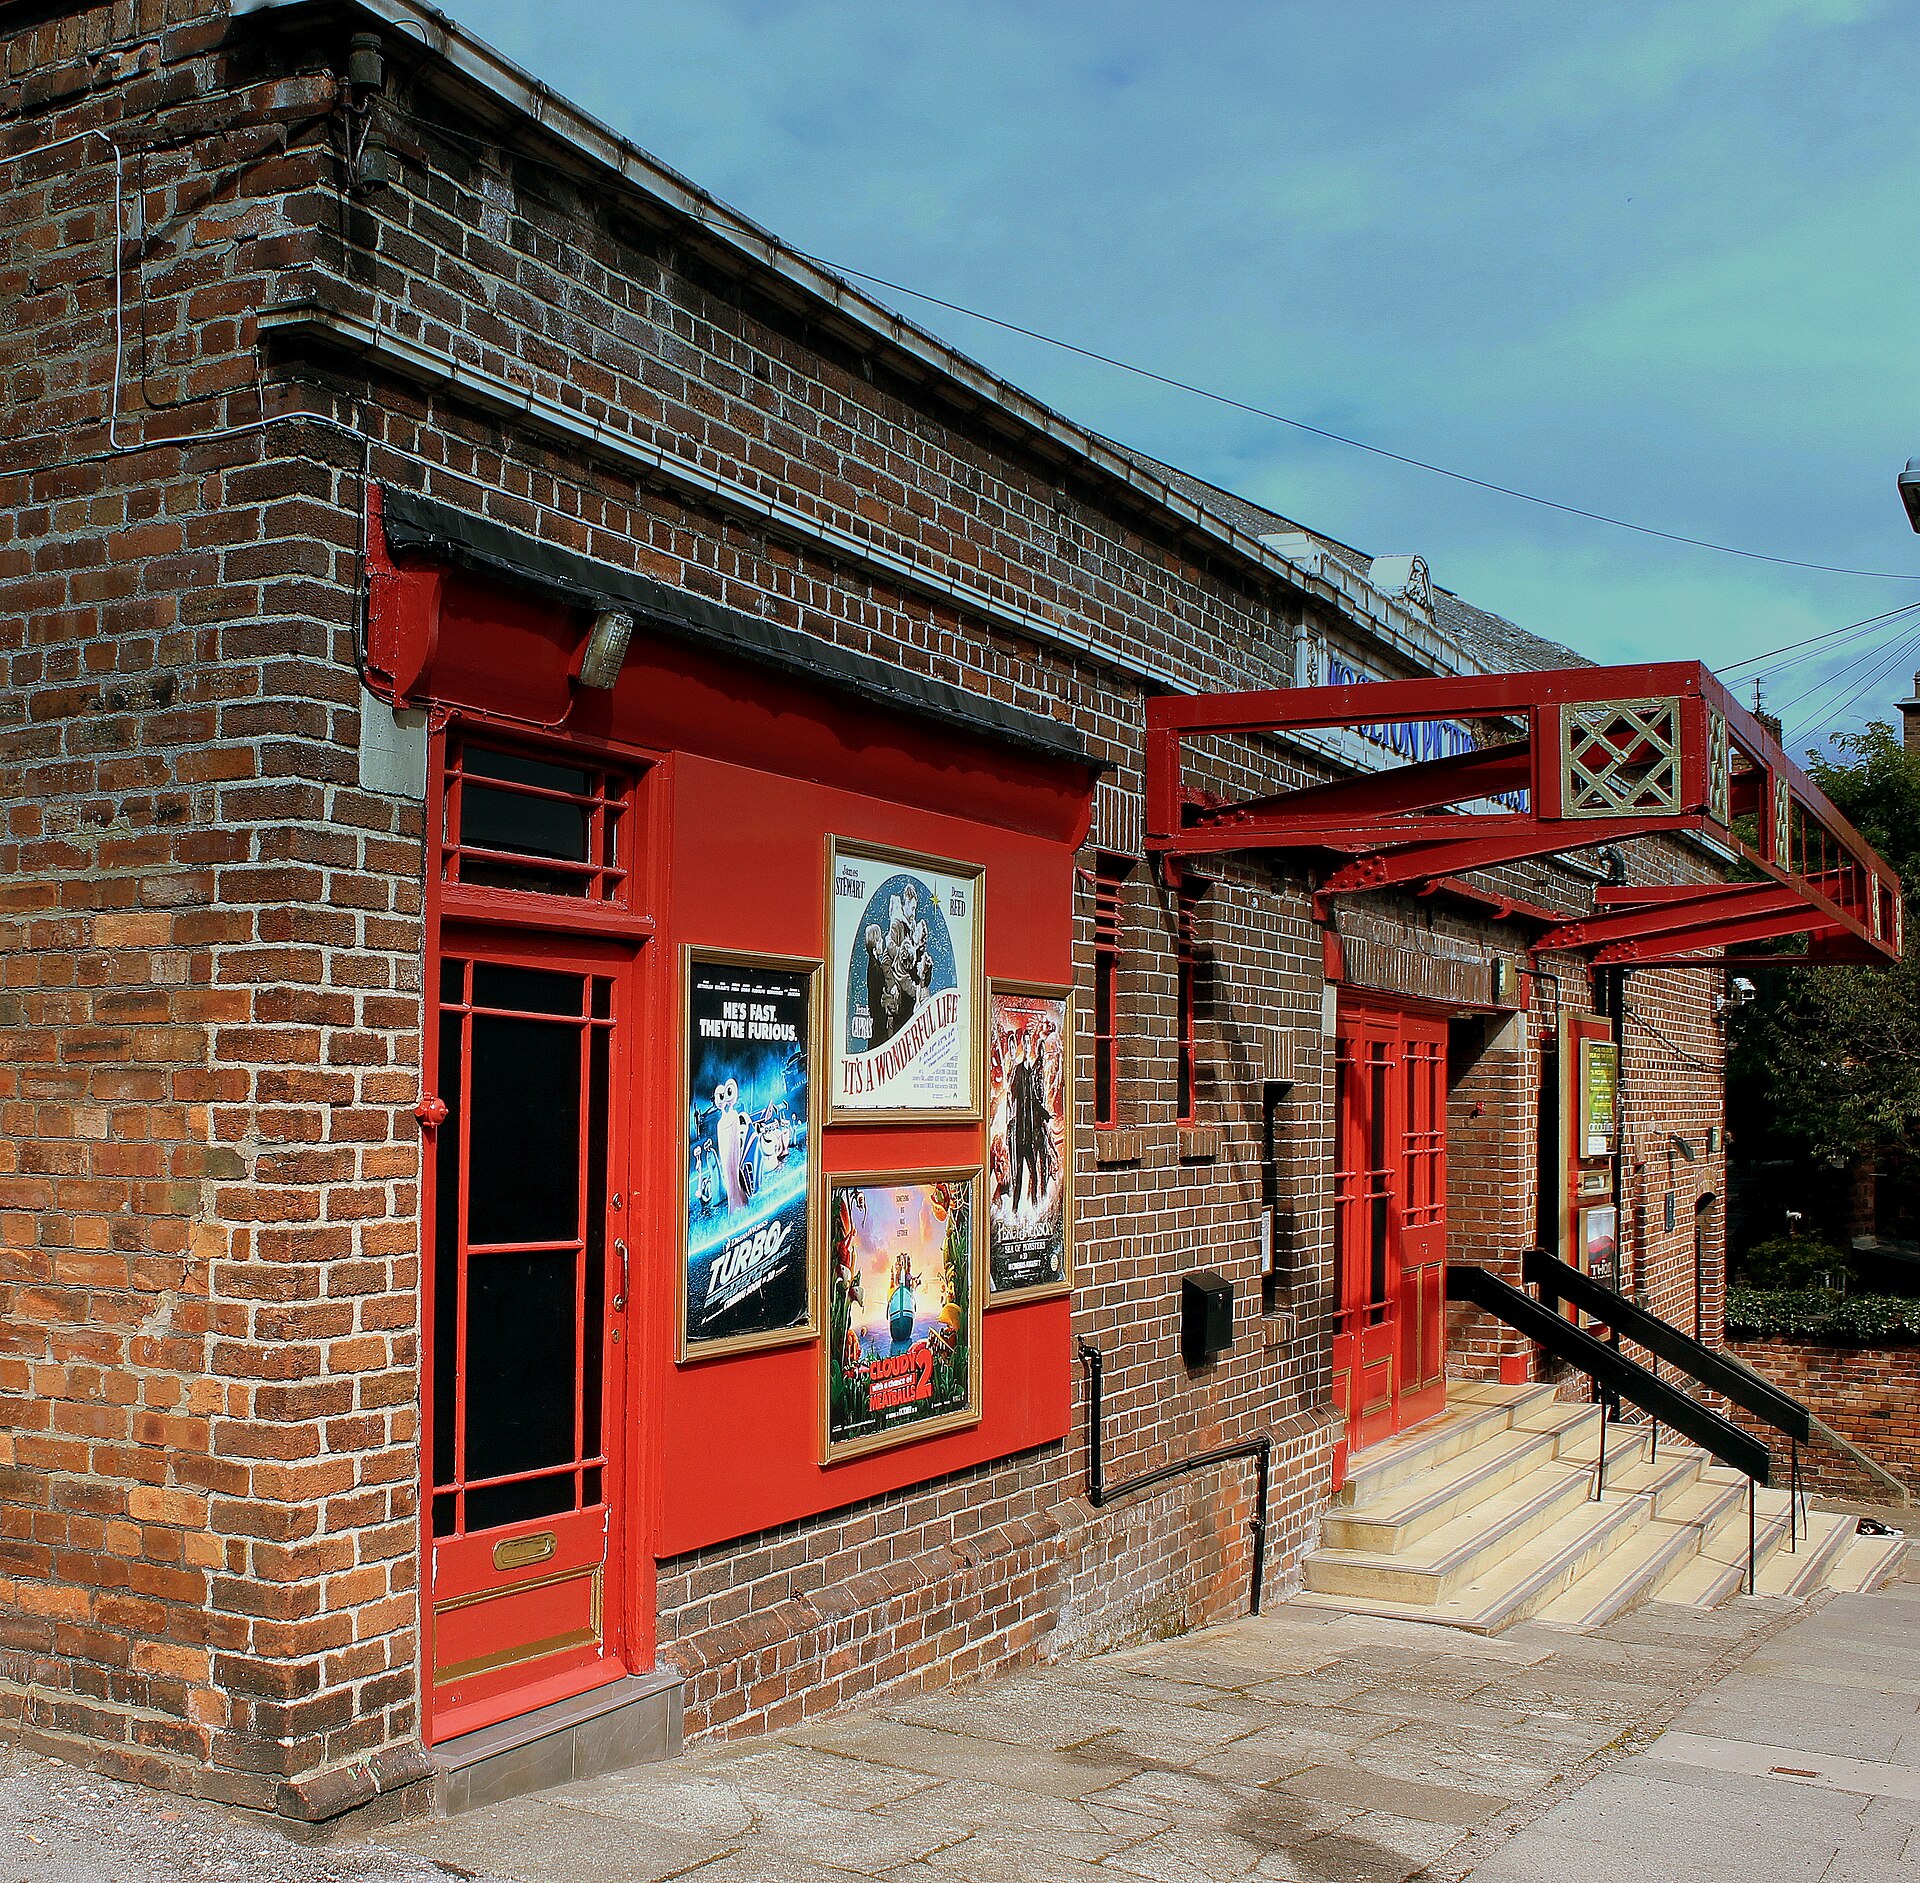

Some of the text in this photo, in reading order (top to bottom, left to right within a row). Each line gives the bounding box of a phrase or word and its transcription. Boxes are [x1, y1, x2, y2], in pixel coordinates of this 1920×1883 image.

[835, 877, 866, 900] STEWART
[949, 899, 966, 917] REED
[723, 1001, 777, 1022] HE'S FAST.
[699, 1018, 798, 1042] THEY'RE FURIOUS.
[866, 1058, 875, 1093] A
[874, 1004, 936, 1087] WONDERFUL
[707, 1220, 794, 1296] TURBO
[1004, 1241, 1046, 1254] SEA OF MONSTERS
[869, 1347, 934, 1400] CLOUDY 2
[871, 1383, 883, 1392] with
[888, 1378, 905, 1387] chance
[905, 1374, 913, 1383] of
[869, 1384, 917, 1412] MEATBALLS
